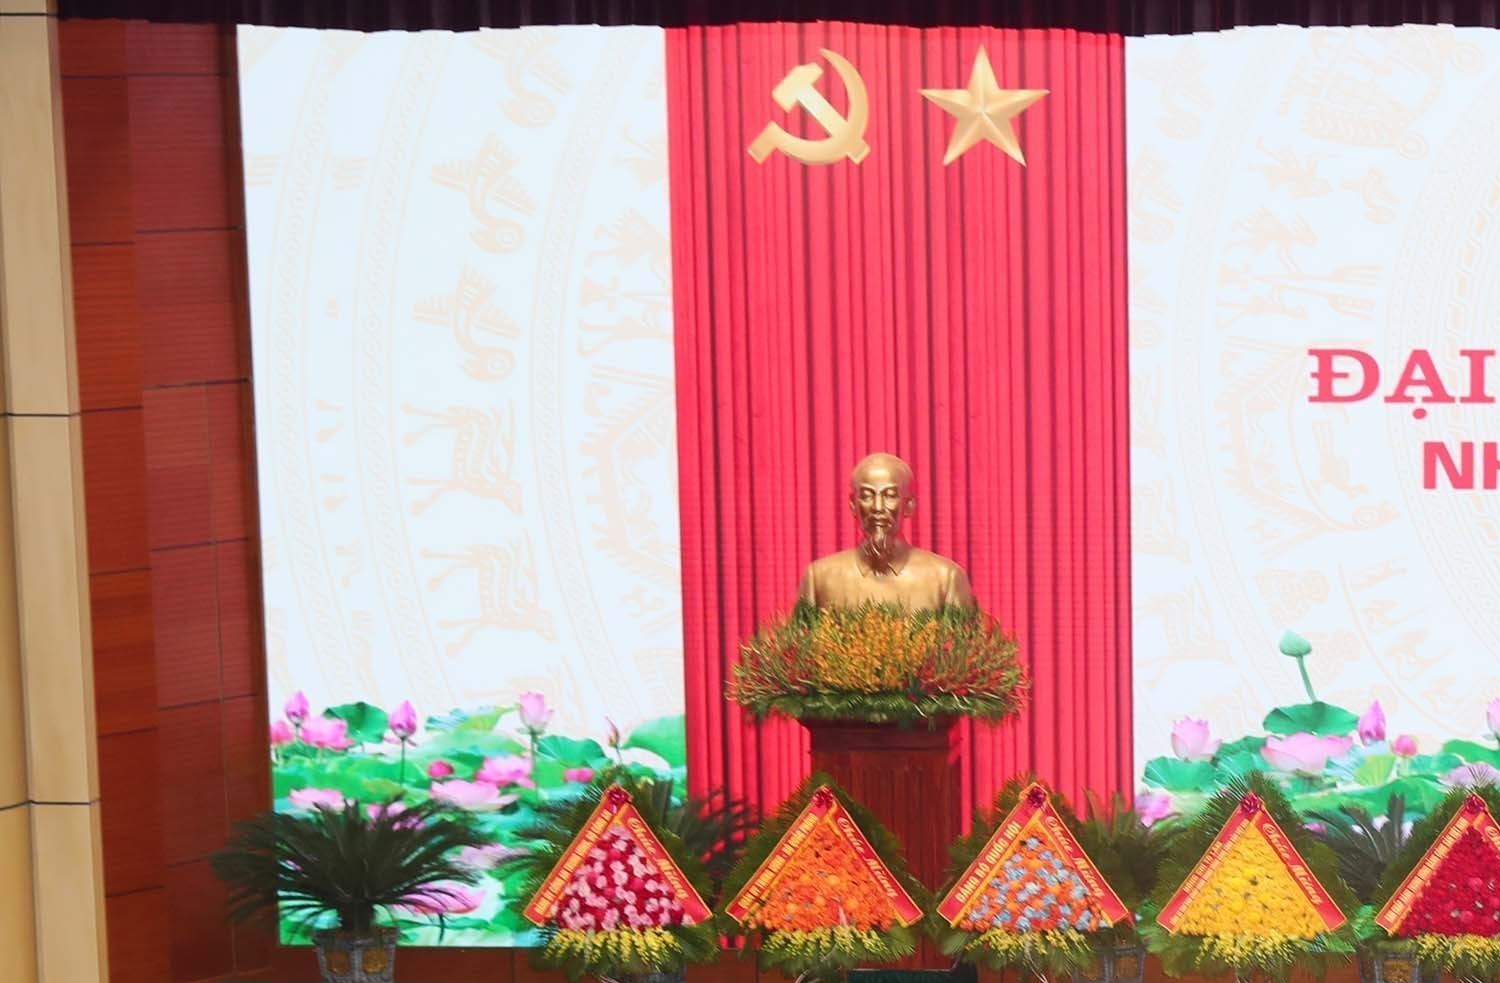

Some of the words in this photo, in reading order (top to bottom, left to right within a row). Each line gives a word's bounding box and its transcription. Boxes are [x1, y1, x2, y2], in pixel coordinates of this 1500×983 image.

[1308, 349, 1495, 419] ĐẠI
[627, 816, 656, 854] Chúc
[655, 858, 688, 899] Mừng
[835, 817, 865, 853] Chúc
[863, 858, 898, 898] Mừng
[953, 874, 979, 903] ĐẢNG
[972, 861, 990, 878] BỘ
[983, 836, 1008, 864] QUỐC
[1001, 819, 1021, 839] HỘI
[1044, 816, 1073, 852] Chúc
[1071, 858, 1105, 897] Mừng
[1261, 823, 1289, 858] Chúc
[1288, 863, 1322, 903] Mừng
